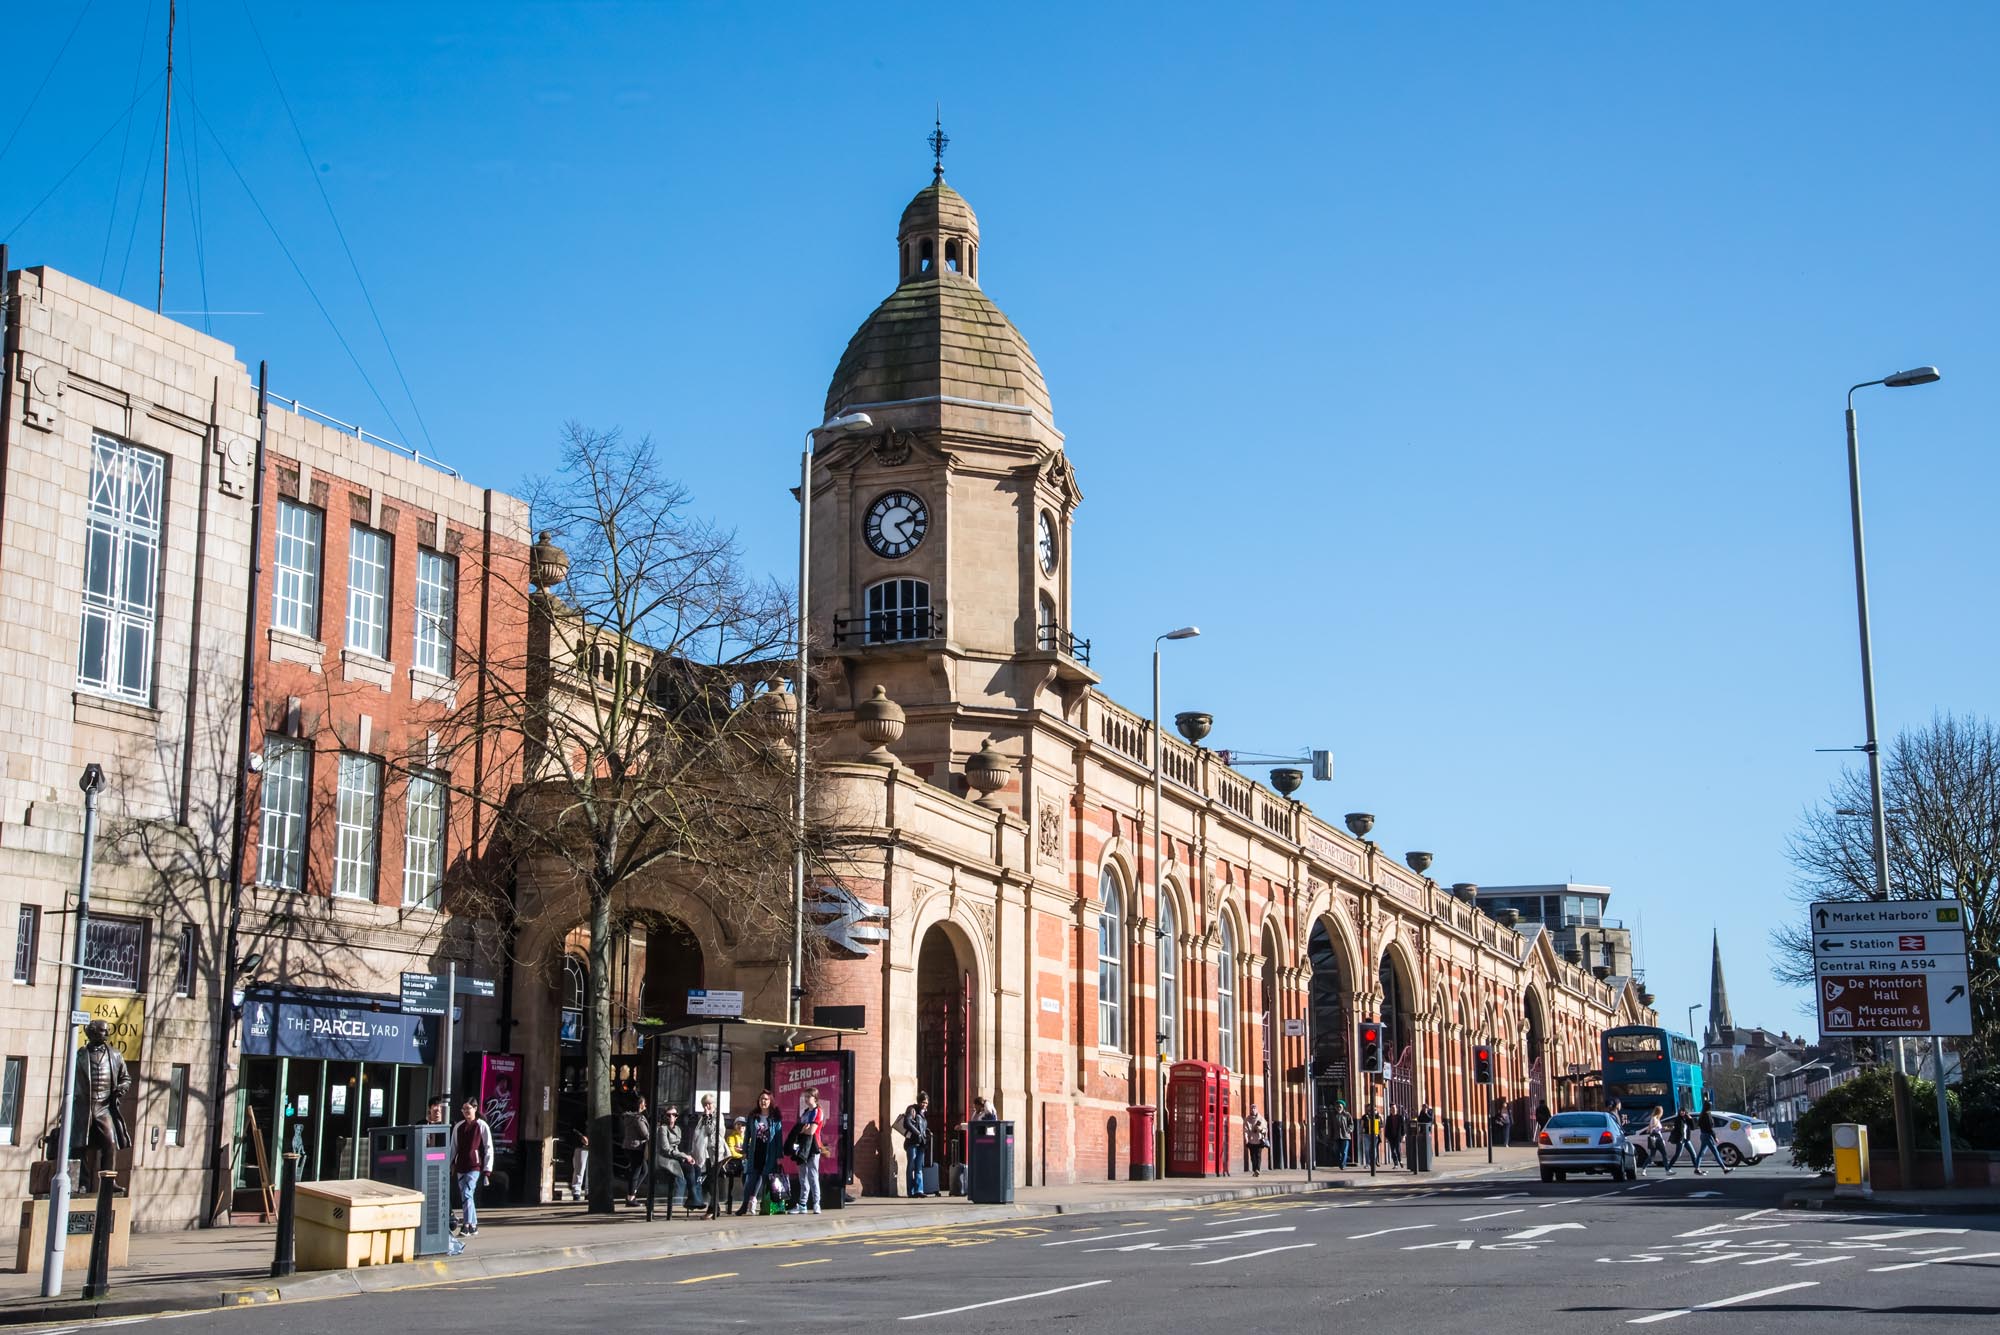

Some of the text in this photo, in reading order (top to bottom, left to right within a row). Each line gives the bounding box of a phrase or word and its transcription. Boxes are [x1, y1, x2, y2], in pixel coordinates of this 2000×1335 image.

[1832, 910, 1932, 922] Market Harboro'
[1850, 939, 1894, 949] Station
[1820, 960, 1864, 971] Central
[1870, 960, 1896, 971] Ring
[1848, 978, 1922, 989] De Montfort
[1874, 991, 1900, 1000] Hall
[94, 1003, 120, 1018] 48A
[1859, 1006, 1920, 1015] Museum &
[287, 1017, 399, 1037] THE PARCEL YARD
[1858, 1016, 1924, 1028] Art Gallery
[789, 1067, 812, 1082] ZERO
[821, 1068, 827, 1076] IT
[778, 1082, 802, 1093] CRUISE
[1400, 1240, 1555, 1250] A6
[1596, 1250, 1856, 1266] STH
